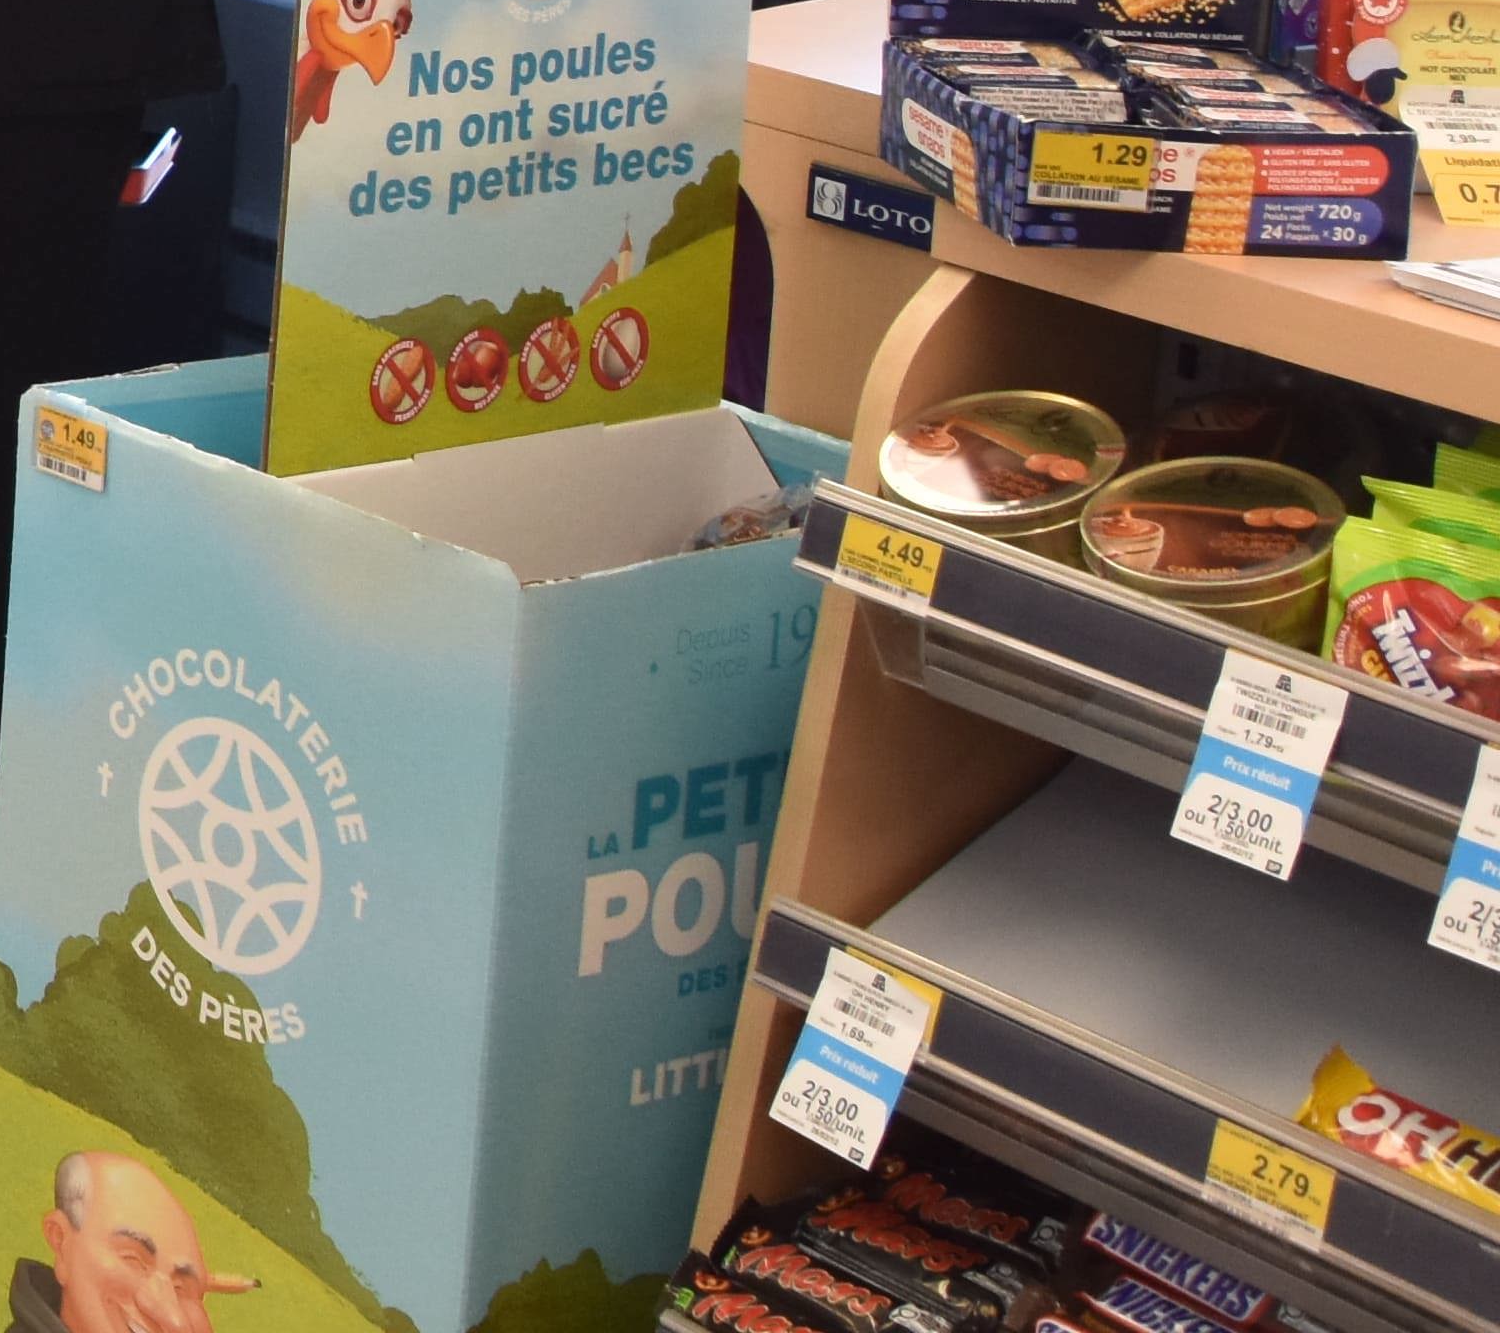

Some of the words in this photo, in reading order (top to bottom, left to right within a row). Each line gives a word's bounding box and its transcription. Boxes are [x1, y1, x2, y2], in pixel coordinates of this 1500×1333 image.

[409, 50, 493, 96] Nos
[511, 34, 656, 94] poules
[1420, 65, 1439, 73] HOT
[1441, 65, 1497, 75] CHOCOLATE
[387, 116, 441, 156] en
[459, 97, 533, 148] ont
[548, 80, 669, 136] sucré
[1092, 142, 1148, 166] 1.29
[350, 170, 431, 217] des
[448, 148, 578, 214] petits
[594, 141, 694, 186] becs
[1035, 171, 1085, 182] COLLATION
[1088, 173, 1102, 182] AU
[854, 199, 931, 234] LOTO
[1318, 204, 1351, 220] 720
[1354, 212, 1361, 222] g
[1261, 224, 1283, 240] 24
[1332, 227, 1355, 241] 30
[1358, 234, 1367, 245] g
[63, 423, 95, 449] 1.49
[877, 535, 924, 568] 4.49
[676, 623, 749, 656] Depuis
[689, 657, 748, 684] Since
[108, 648, 368, 845] CHOCOLATERIE
[1223, 756, 1250, 775] Prix
[1251, 767, 1291, 791] réduit
[1184, 808, 1205, 824] ou
[1208, 794, 1273, 833] 2/3.00
[587, 832, 619, 860] LA
[1443, 916, 1467, 933] ou
[130, 925, 192, 1007] DES
[199, 990, 305, 1045] PÈRES
[678, 964, 727, 997] DES
[820, 1044, 842, 1065] Prix
[843, 1058, 879, 1084] réduit
[782, 1090, 800, 1108] ou
[802, 1080, 859, 1121] 2/3.00
[1251, 1154, 1310, 1197] 2.79
[738, 1243, 892, 1316] Mars
[1098, 1213, 1268, 1322] SNICKERS
